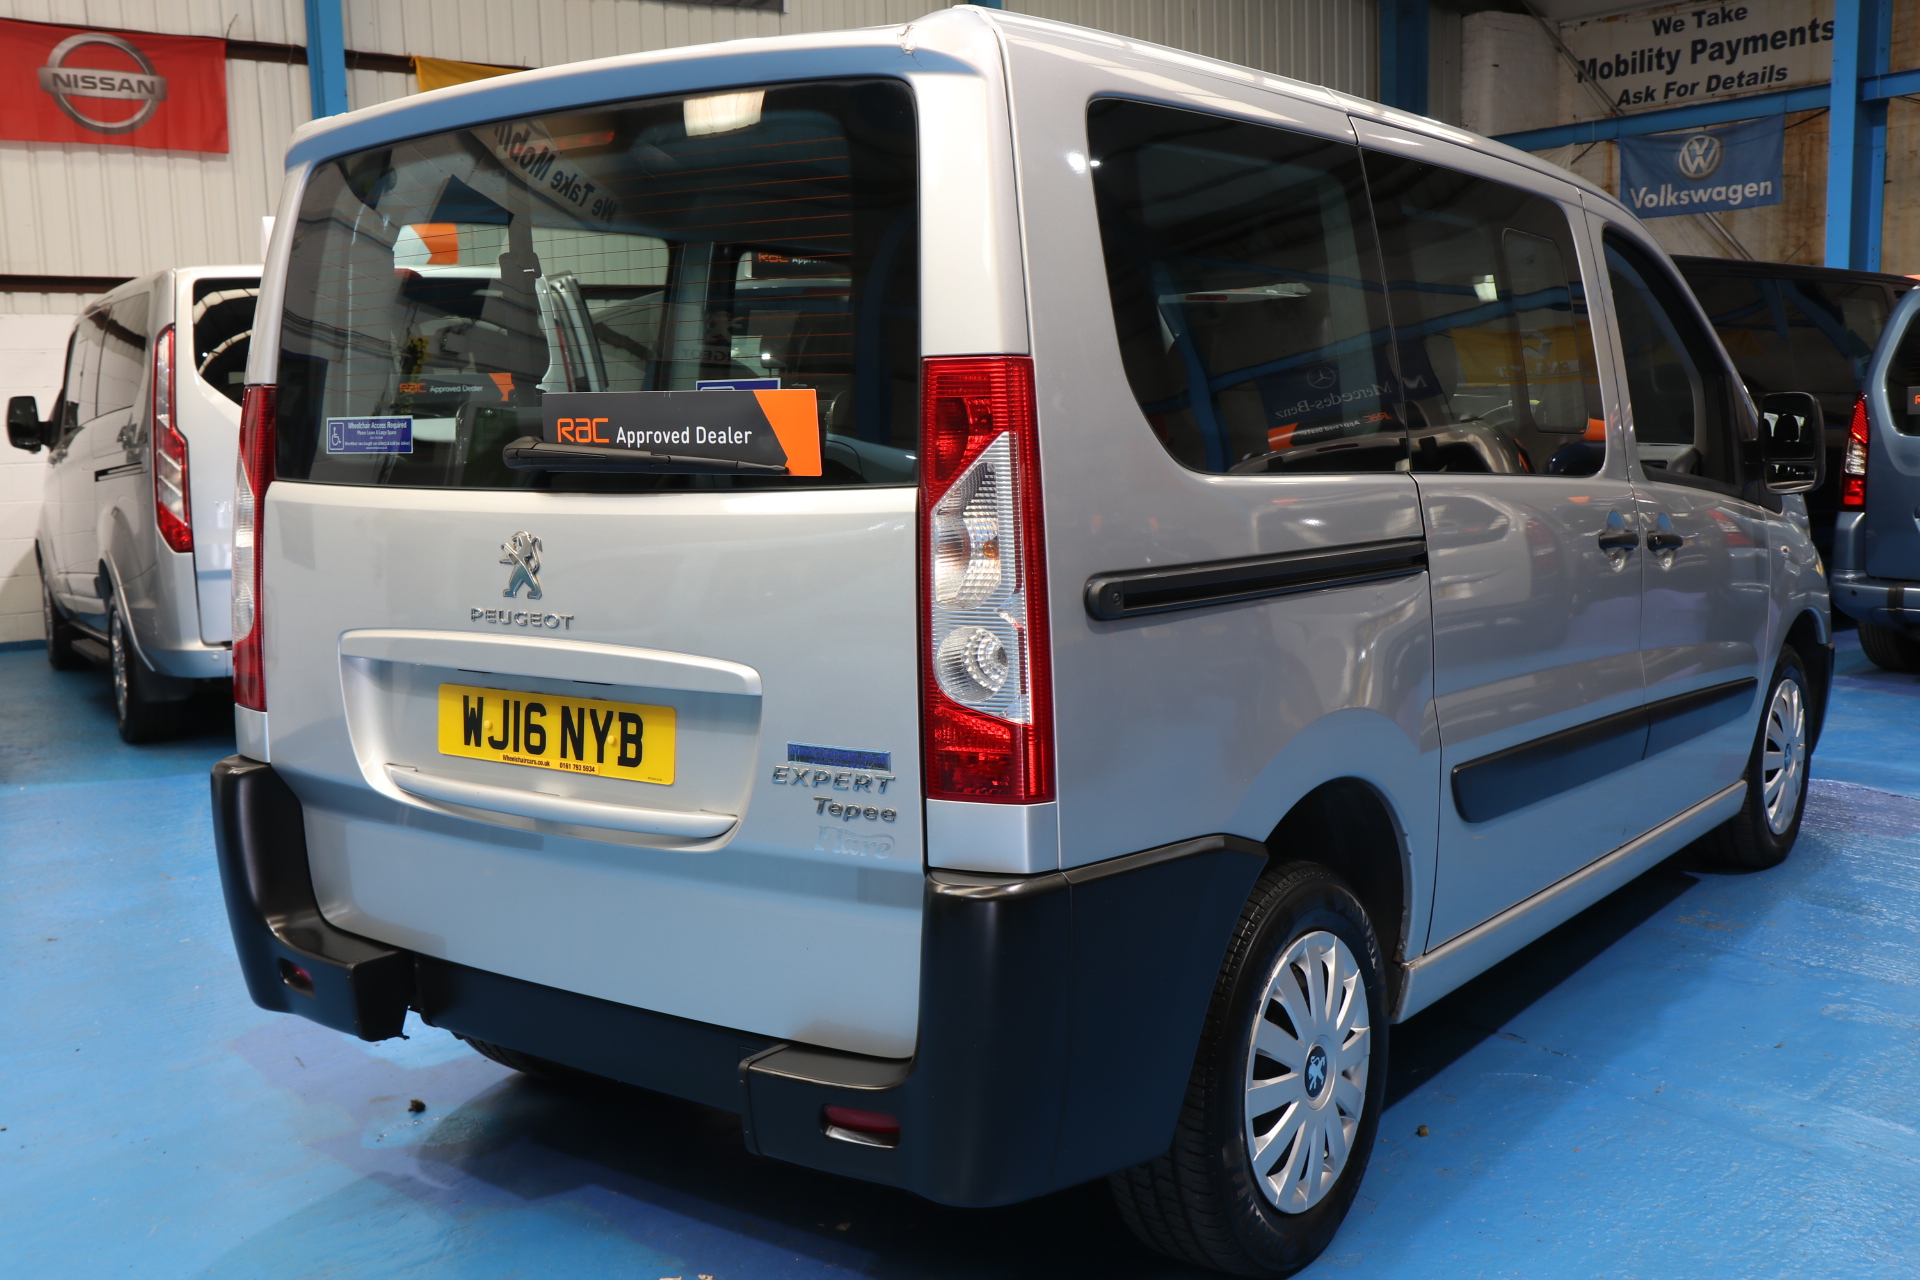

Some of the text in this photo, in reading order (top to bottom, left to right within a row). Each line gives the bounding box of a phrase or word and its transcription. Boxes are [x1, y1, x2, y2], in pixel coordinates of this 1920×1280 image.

[1652, 6, 1748, 37] We Take
[1577, 18, 1835, 83] Mobility Payments
[51, 72, 156, 95] NISSAN
[1616, 64, 1788, 107] Ask For Details
[1630, 180, 1772, 209] Volkswagen
[429, 385, 462, 394] Approved
[462, 384, 484, 392] Dealer
[387, 421, 407, 430] Required
[616, 426, 690, 448] Approved
[696, 426, 752, 444] Dealer
[470, 607, 575, 630] PEUGEOT
[463, 694, 644, 768] WJ16 NYB
[573, 763, 582, 771] 793
[771, 765, 896, 794] EXPERT
[813, 795, 897, 822] Tepee
